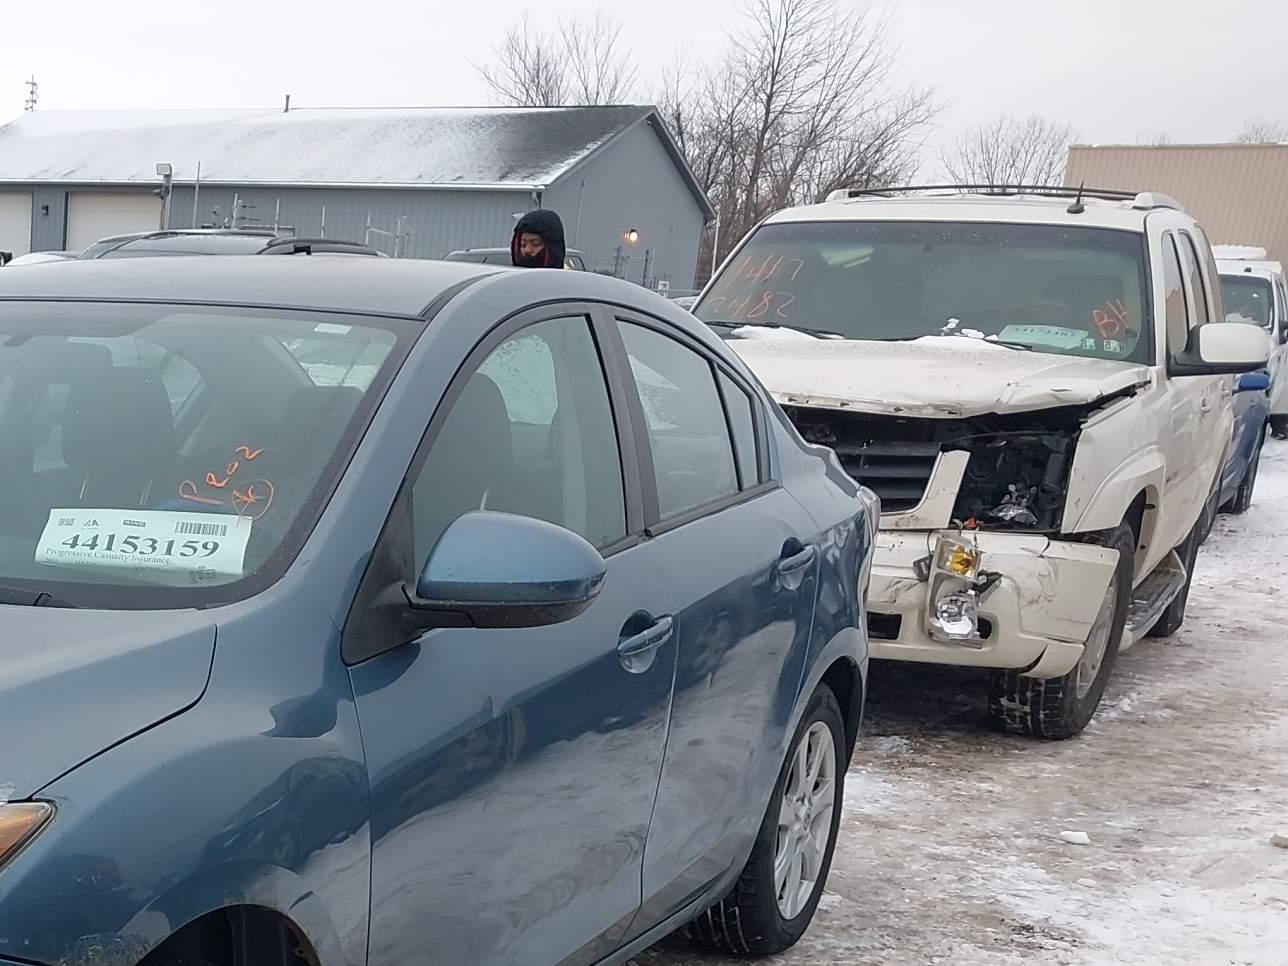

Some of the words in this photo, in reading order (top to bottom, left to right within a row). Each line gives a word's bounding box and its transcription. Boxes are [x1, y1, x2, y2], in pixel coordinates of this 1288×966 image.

[45, 547, 92, 559] Progressive
[94, 551, 130, 563] Casualty
[61, 533, 220, 559] 44153159
